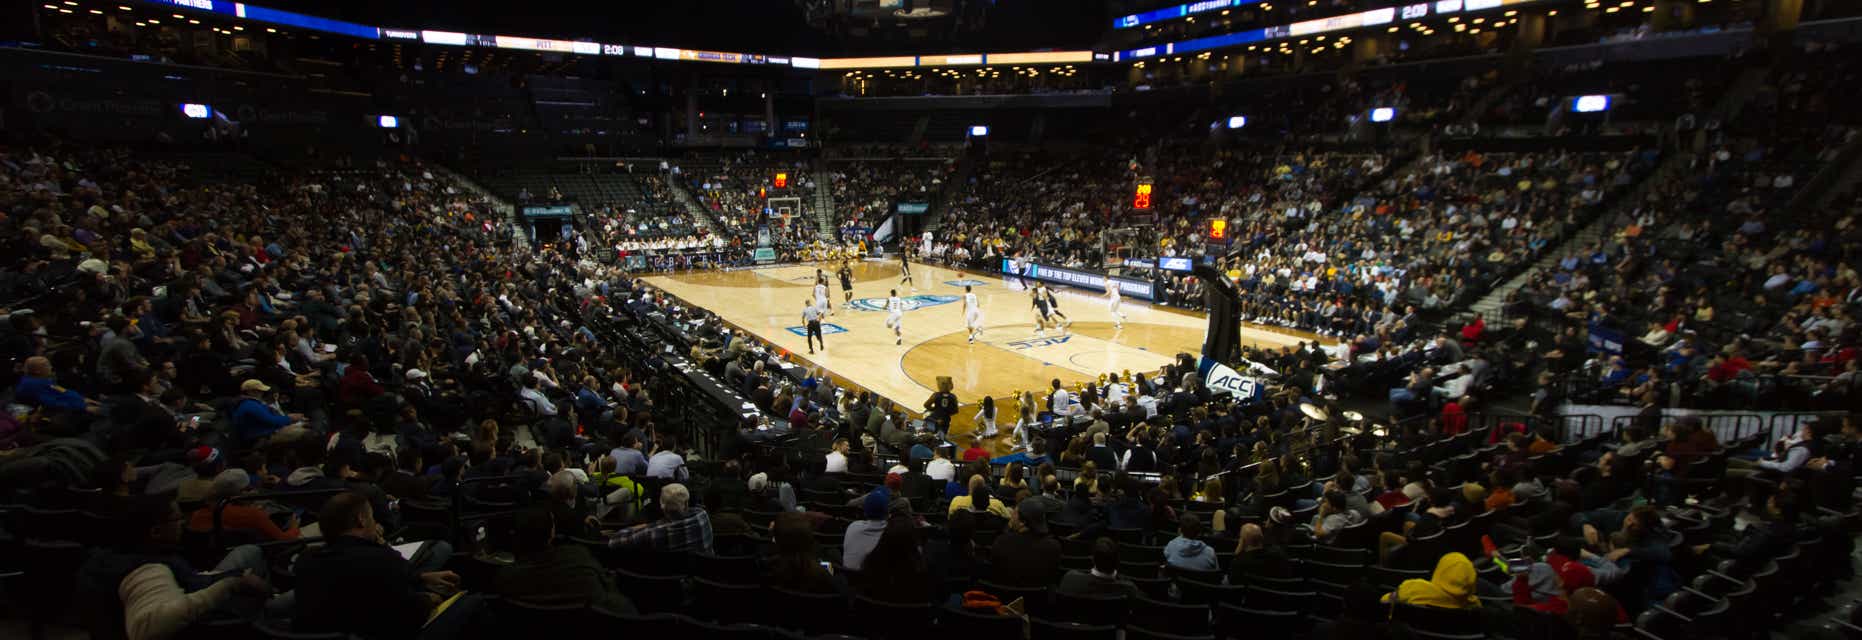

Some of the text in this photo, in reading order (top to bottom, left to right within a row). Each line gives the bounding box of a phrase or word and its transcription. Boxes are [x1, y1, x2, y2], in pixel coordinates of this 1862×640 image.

[1038, 267, 1048, 278] FIVE
[1048, 269, 1054, 278] OF
[1054, 270, 1063, 280] THE
[1063, 271, 1072, 281] TOP
[1213, 375, 1252, 392] ACC
